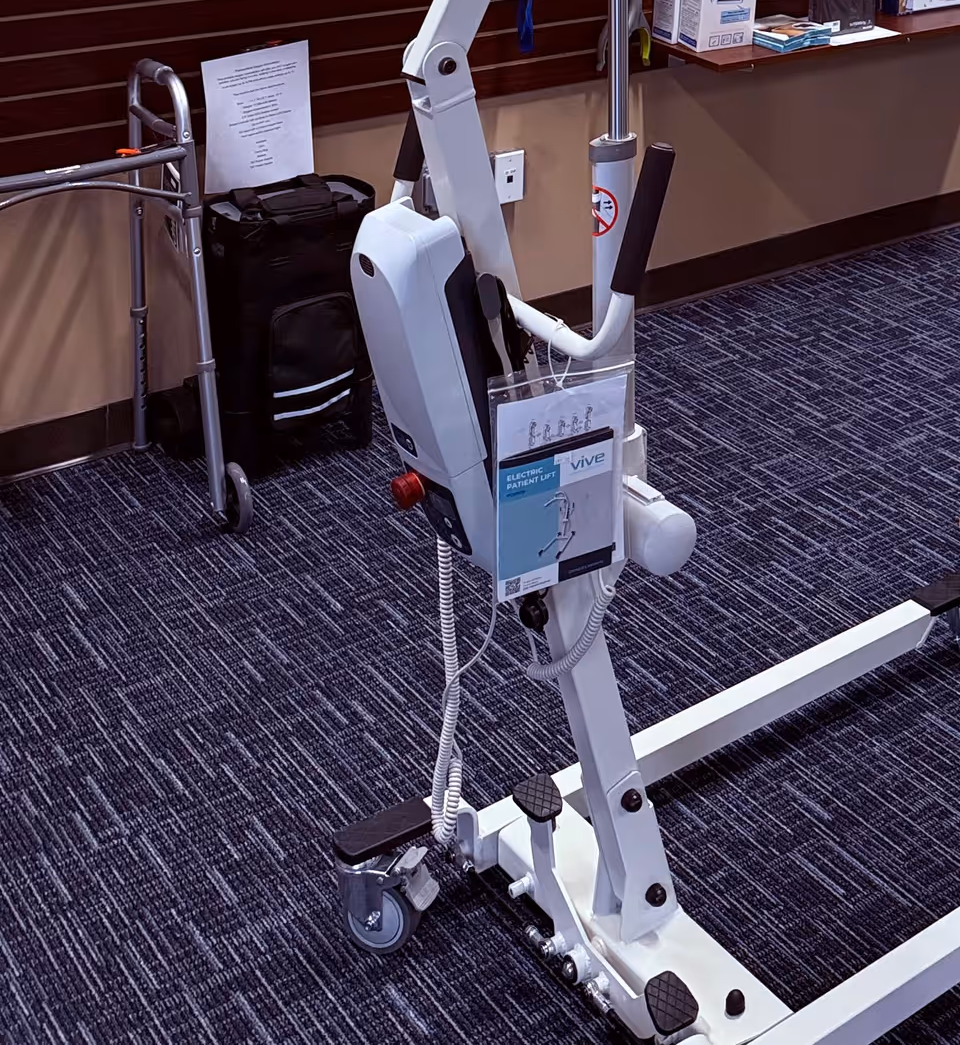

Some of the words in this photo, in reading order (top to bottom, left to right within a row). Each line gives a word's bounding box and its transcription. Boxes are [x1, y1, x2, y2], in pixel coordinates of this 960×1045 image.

[570, 452, 605, 471] vive
[506, 466, 544, 483] ELECTRIC
[506, 476, 539, 491] PATIENT
[540, 471, 557, 483] LIFT
